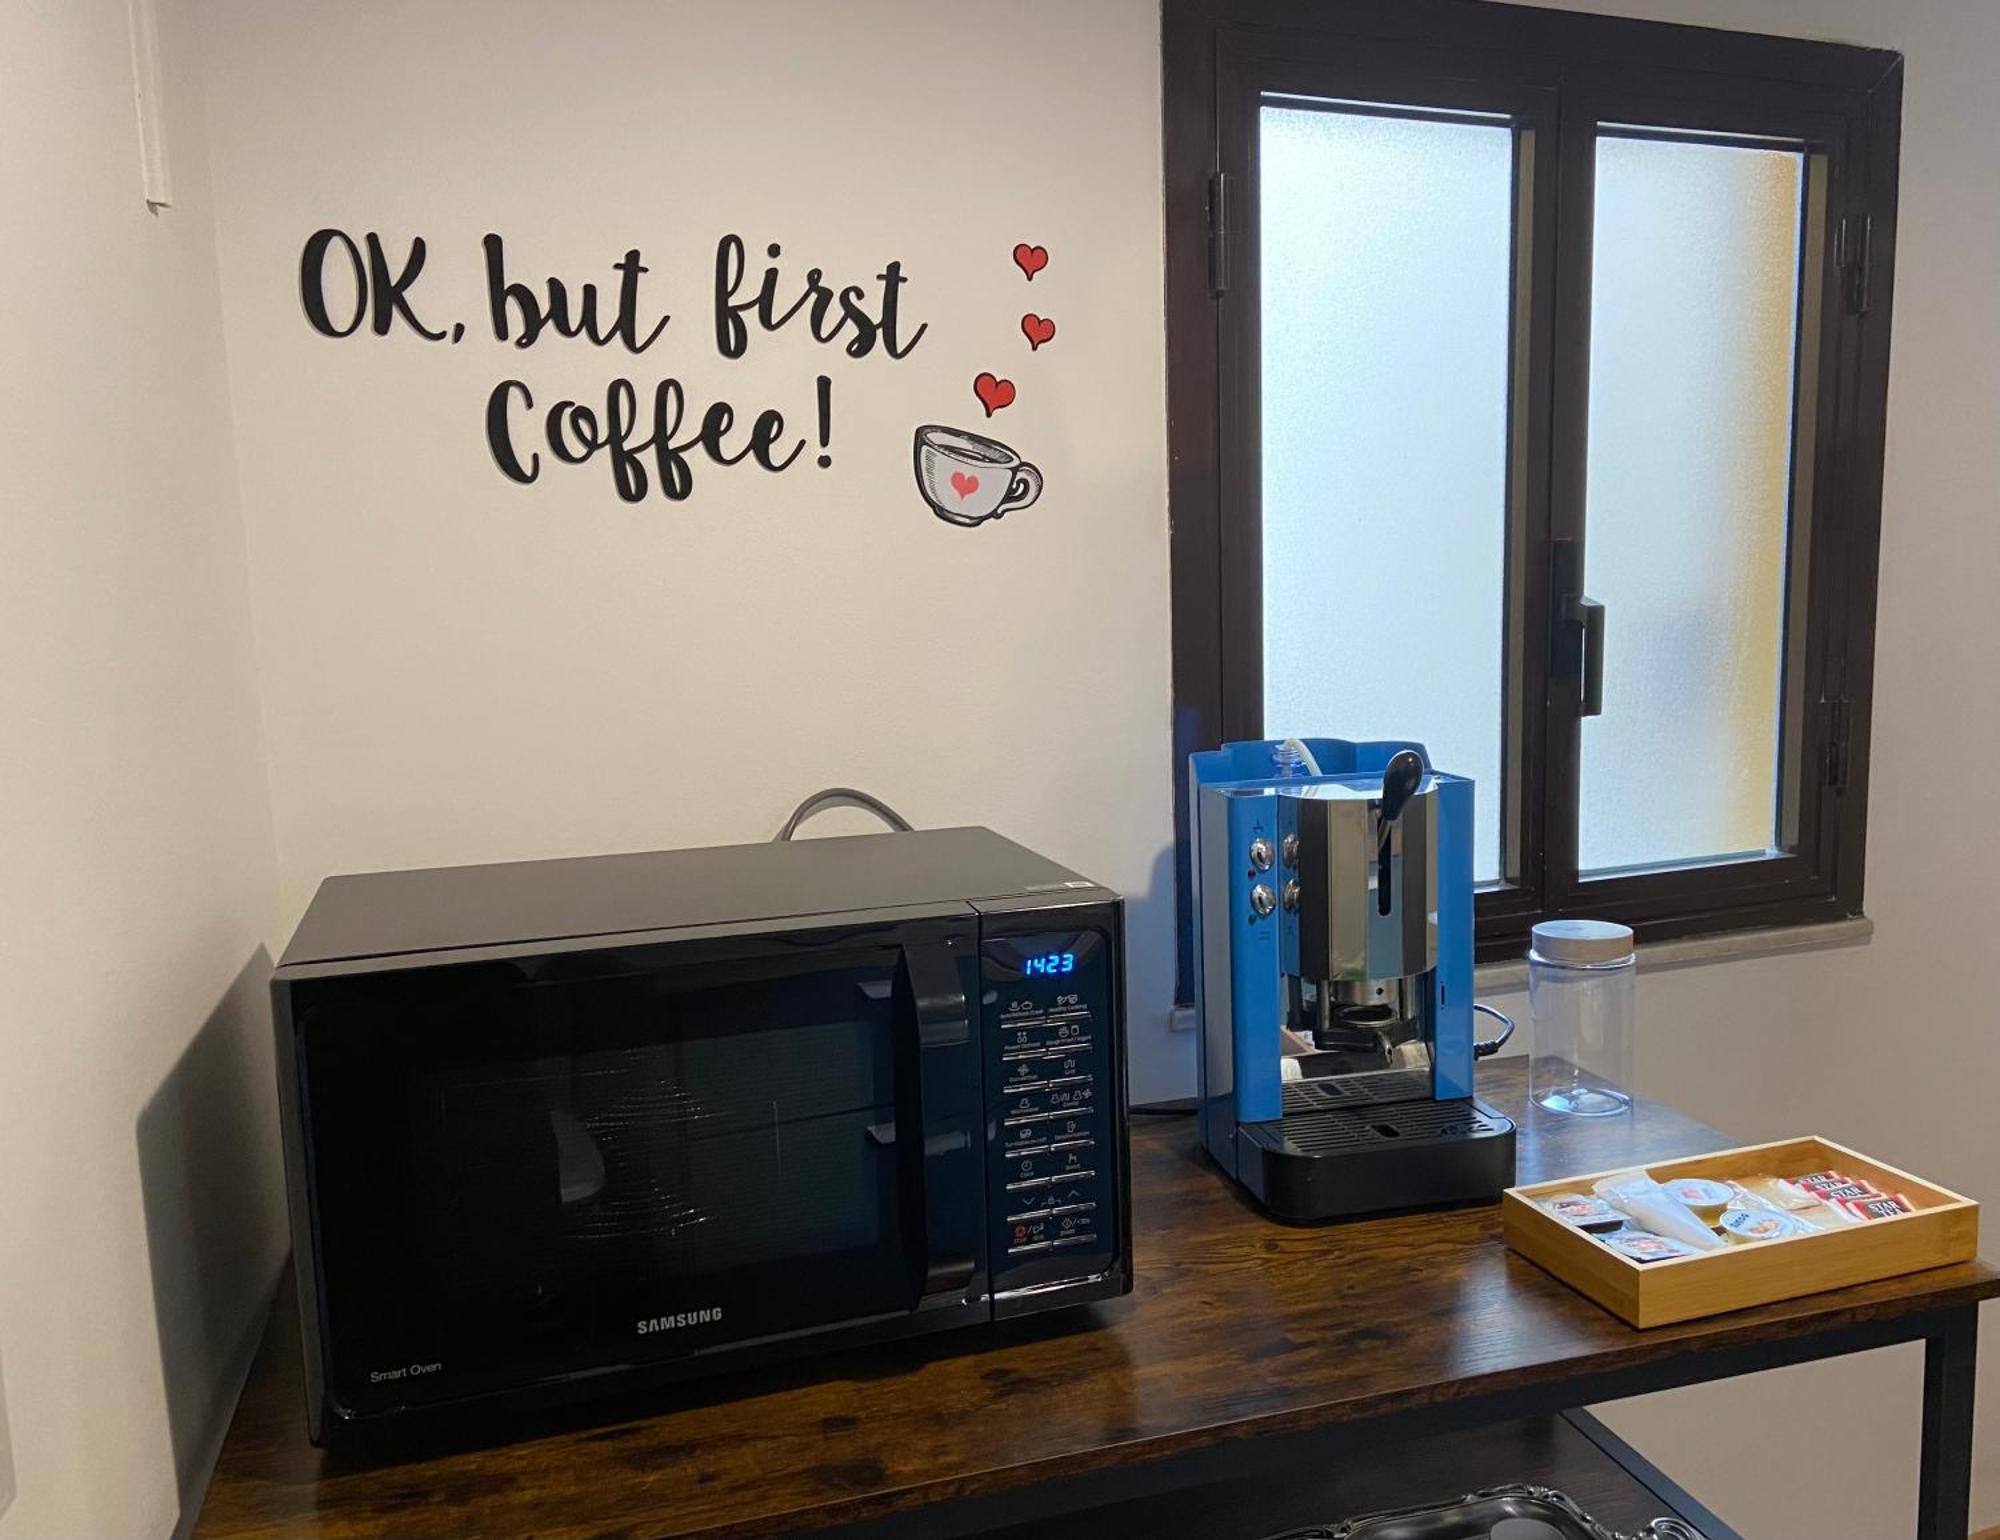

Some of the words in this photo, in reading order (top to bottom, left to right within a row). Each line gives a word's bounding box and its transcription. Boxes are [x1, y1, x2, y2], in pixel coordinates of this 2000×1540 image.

[299, 228, 465, 344] OK,
[483, 233, 671, 355] but
[714, 233, 928, 360] first
[485, 375, 833, 504] Coffee!
[1025, 953, 1075, 975] 1423
[1830, 1186, 1862, 1198] STAR
[1868, 1200, 1901, 1213] STAR
[637, 1307, 723, 1334] SAMSUNG
[370, 1367, 408, 1383] Smart
[410, 1362, 442, 1376] Oven
